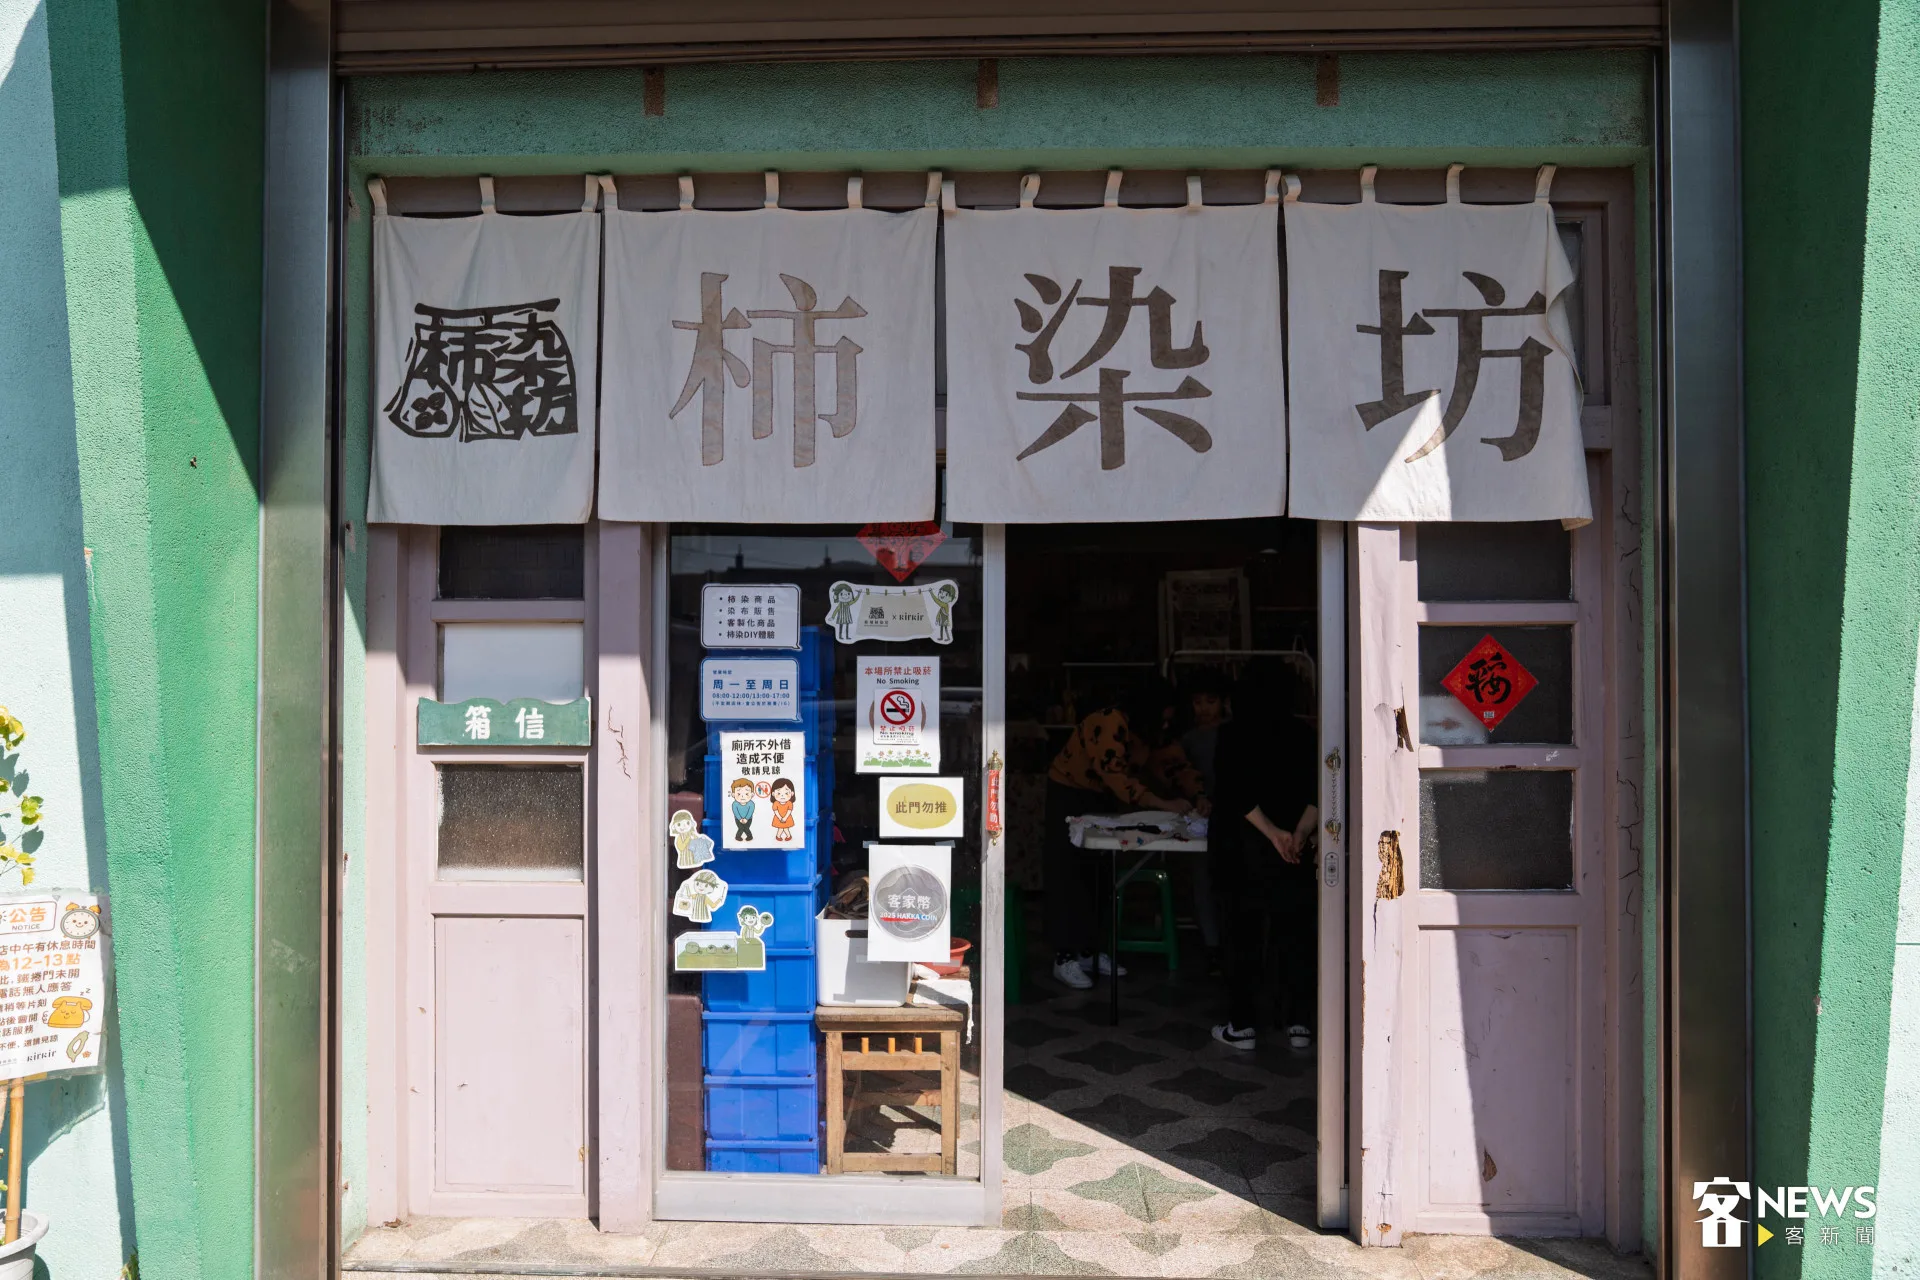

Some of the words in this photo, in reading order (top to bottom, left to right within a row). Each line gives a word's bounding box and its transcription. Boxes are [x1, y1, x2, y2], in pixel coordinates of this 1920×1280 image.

[670, 265, 1553, 470] 柿染坊
[727, 595, 776, 604] 柿染商品
[727, 607, 776, 616] 染布販售
[727, 619, 776, 628] 客製化商品
[727, 631, 776, 640] 柿染DIY體驗
[864, 666, 932, 676] 本場所禁止吸菸
[712, 679, 790, 691] 周一至周日
[889, 677, 920, 686] Smoking
[712, 692, 790, 700] 08:00-12:00/13:00-17:00
[731, 738, 792, 751] 廁所不外借
[736, 752, 785, 765] 造成不便
[741, 766, 781, 776] 敬請見諒
[895, 800, 948, 815] 此門勿推
[888, 894, 931, 909] 客家幣
[9, 906, 47, 923] 公告
[897, 912, 920, 920] HAKKA
[12, 923, 41, 931] NOTICE
[0, 998, 47, 1013] 稍等片刻
[0, 1024, 34, 1037] 話服務
